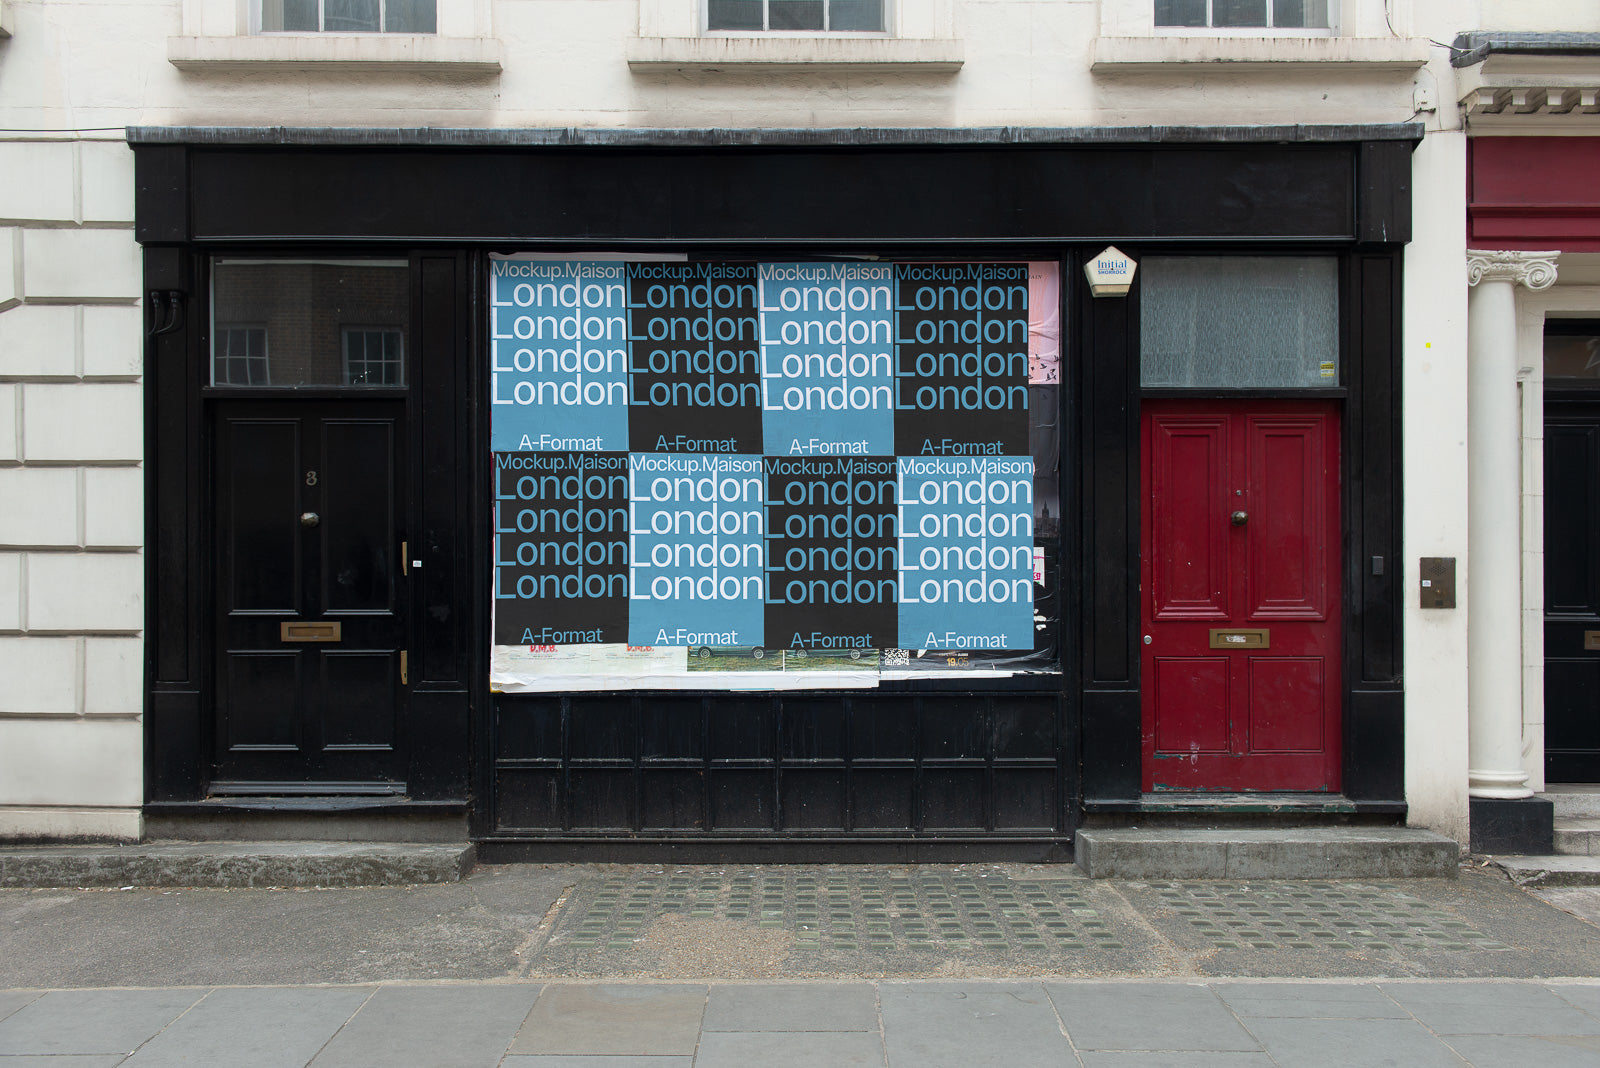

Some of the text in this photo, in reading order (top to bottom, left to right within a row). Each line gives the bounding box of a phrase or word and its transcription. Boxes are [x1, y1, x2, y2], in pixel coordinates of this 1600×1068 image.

[491, 261, 624, 281] Mockup.Maison
[626, 262, 757, 282] Mockup.Maison
[758, 264, 892, 284] Mockup.Maison
[895, 264, 1028, 283] Mockup.Maison
[1098, 260, 1127, 268] Initial
[491, 275, 626, 308] London
[626, 276, 757, 308] London
[758, 278, 891, 312] London
[895, 278, 1028, 311] London
[492, 307, 626, 340] London
[627, 308, 758, 340] London
[760, 312, 892, 344] London
[895, 311, 1028, 344] London
[492, 340, 627, 372] London
[628, 342, 760, 374] London
[761, 345, 892, 378] London
[895, 344, 1028, 377] London
[492, 373, 628, 406] London
[629, 374, 760, 406] London
[763, 378, 892, 410] London
[895, 377, 1028, 410] London
[518, 434, 603, 450] A-Format
[656, 435, 737, 452] A-Format
[790, 438, 869, 454] A-Format
[921, 439, 1004, 455] A-Format
[306, 470, 317, 486] 3
[496, 454, 628, 473] Mockup.Maison
[630, 456, 762, 475] Mockup.Maison
[764, 458, 898, 478] Mockup.Maison
[899, 458, 1032, 478] Mockup.Maison
[496, 467, 628, 500] London
[630, 468, 763, 502] London
[764, 472, 898, 505] London
[898, 472, 1032, 504] London
[496, 500, 628, 533] London
[630, 502, 763, 534] London
[764, 505, 898, 538] London
[898, 505, 1032, 538] London
[496, 533, 628, 566] London
[630, 535, 763, 567] London
[764, 538, 898, 571] London
[898, 538, 1032, 570] London
[496, 566, 628, 599] London
[630, 568, 763, 600] London
[765, 571, 898, 604] London
[899, 571, 1032, 603] London
[521, 628, 603, 644] A-Format
[656, 628, 738, 644] A-Format
[790, 632, 872, 648] A-Format
[925, 632, 1007, 648] A-Format
[946, 658, 968, 666] 19.05
